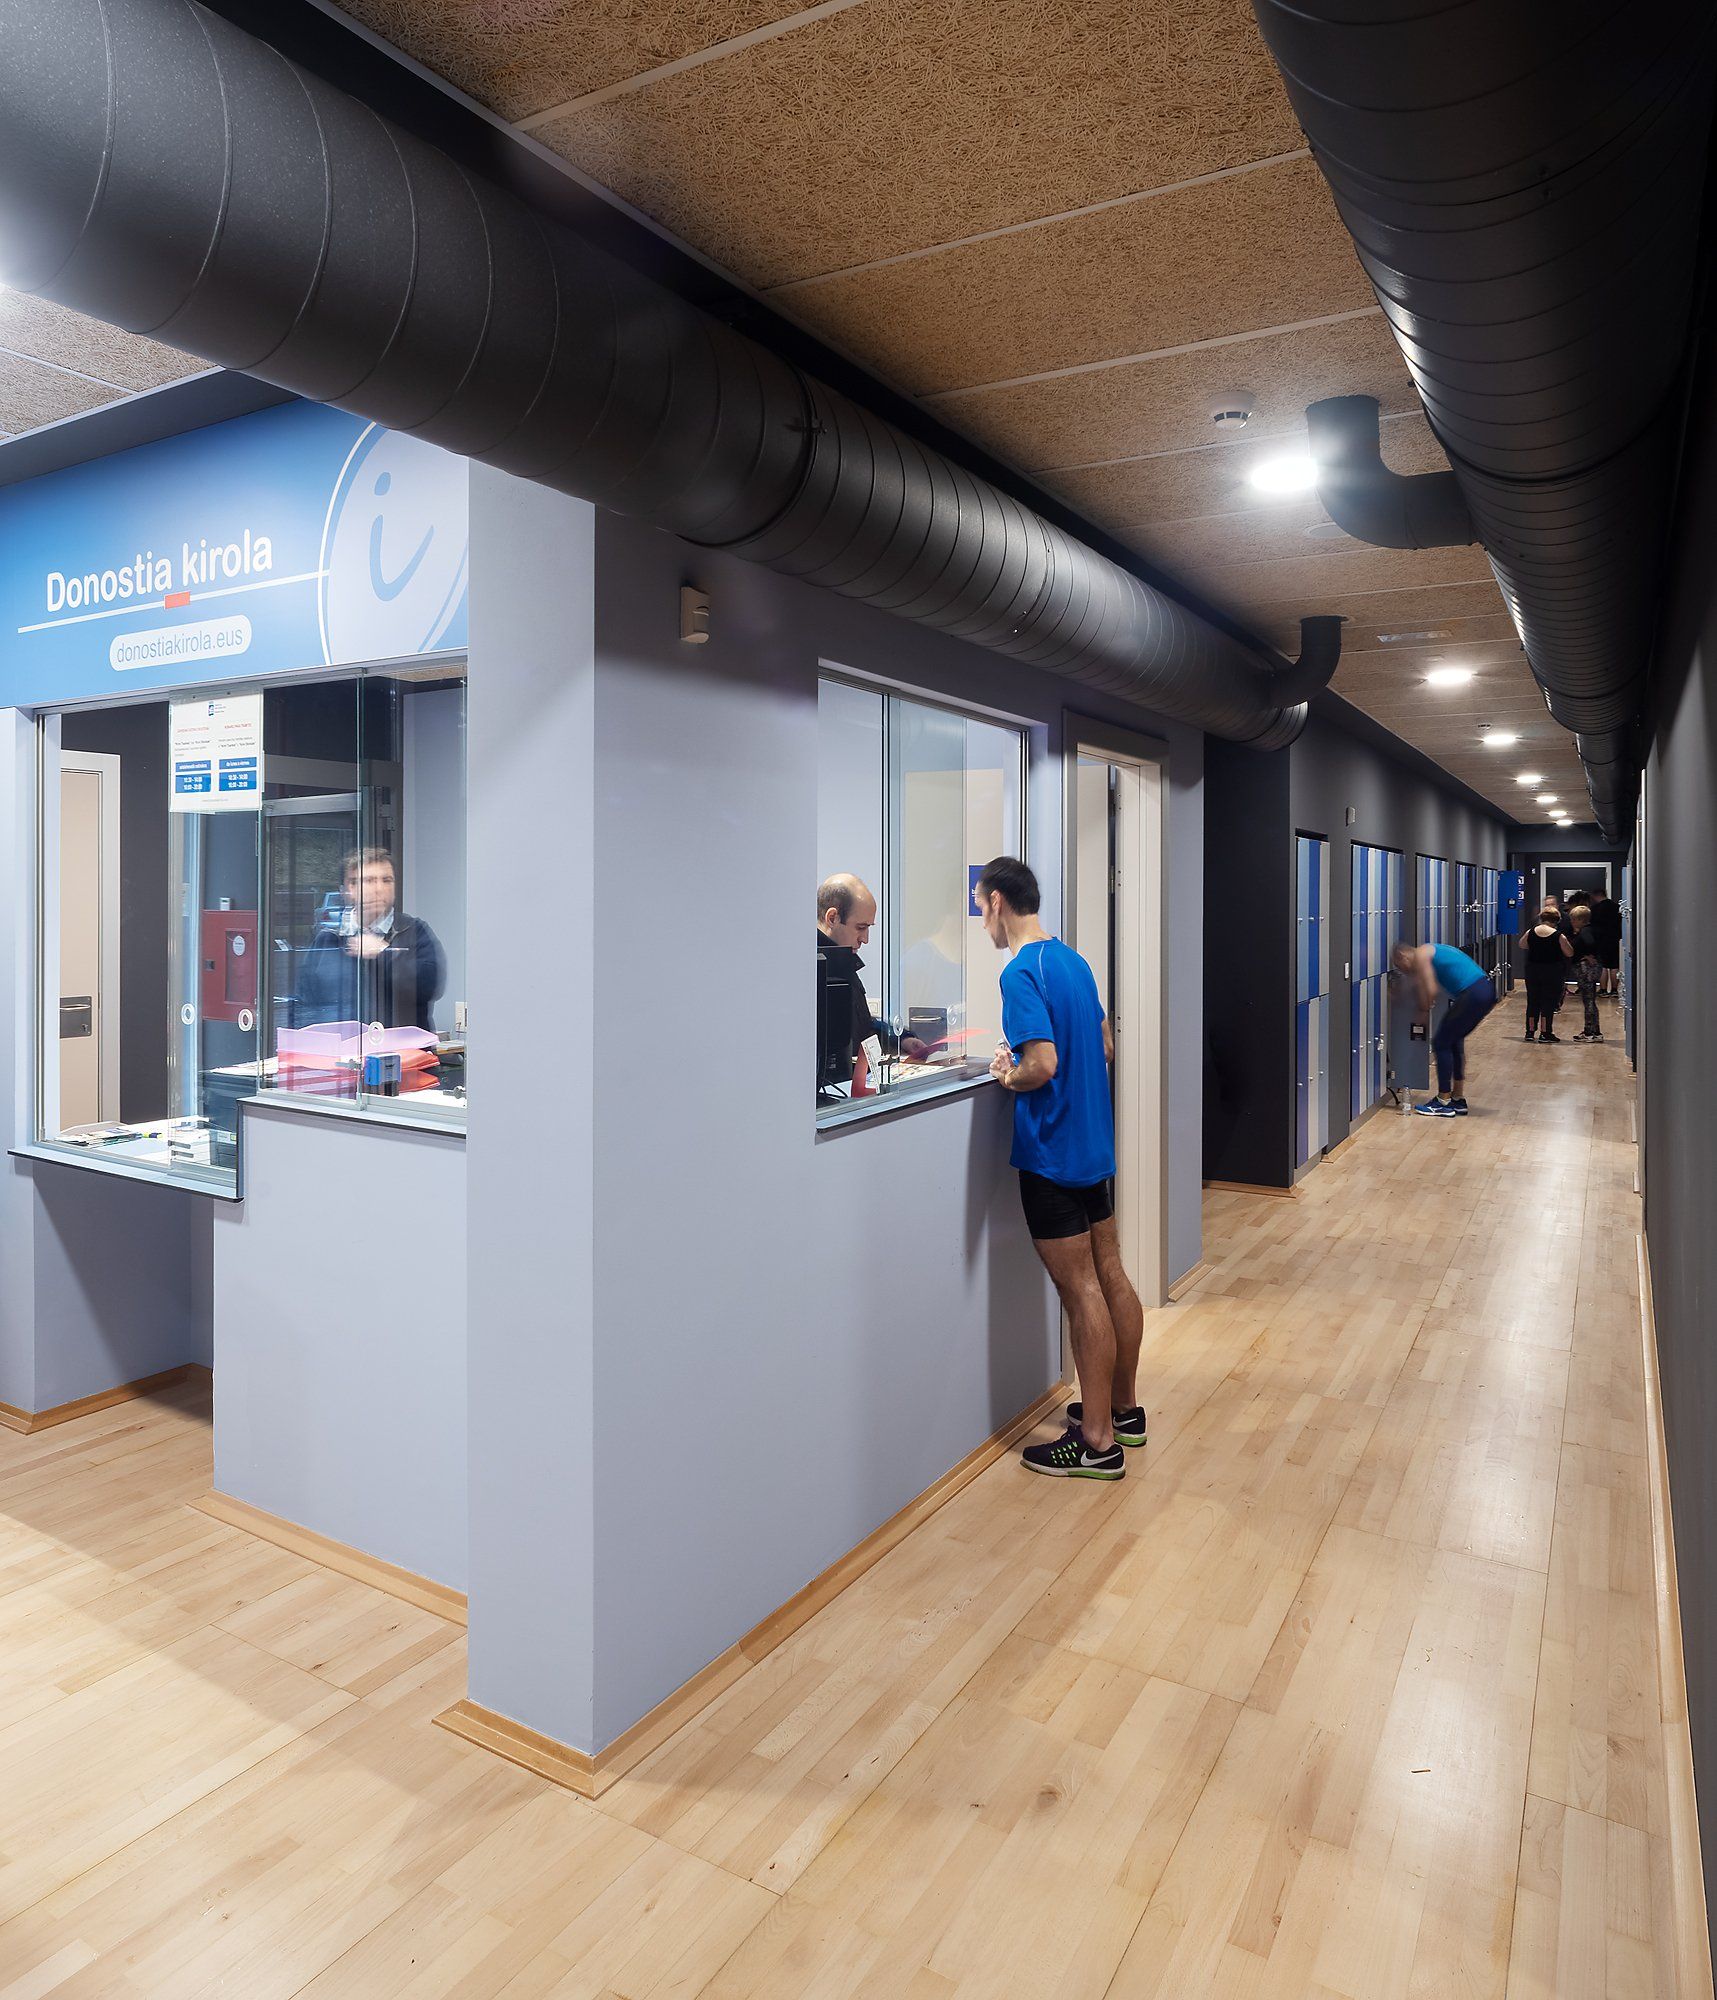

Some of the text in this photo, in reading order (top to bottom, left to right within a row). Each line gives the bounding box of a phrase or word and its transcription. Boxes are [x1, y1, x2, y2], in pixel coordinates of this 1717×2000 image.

[46, 528, 272, 613] Donostia kirola
[116, 625, 243, 664] donostiakirola.eus
